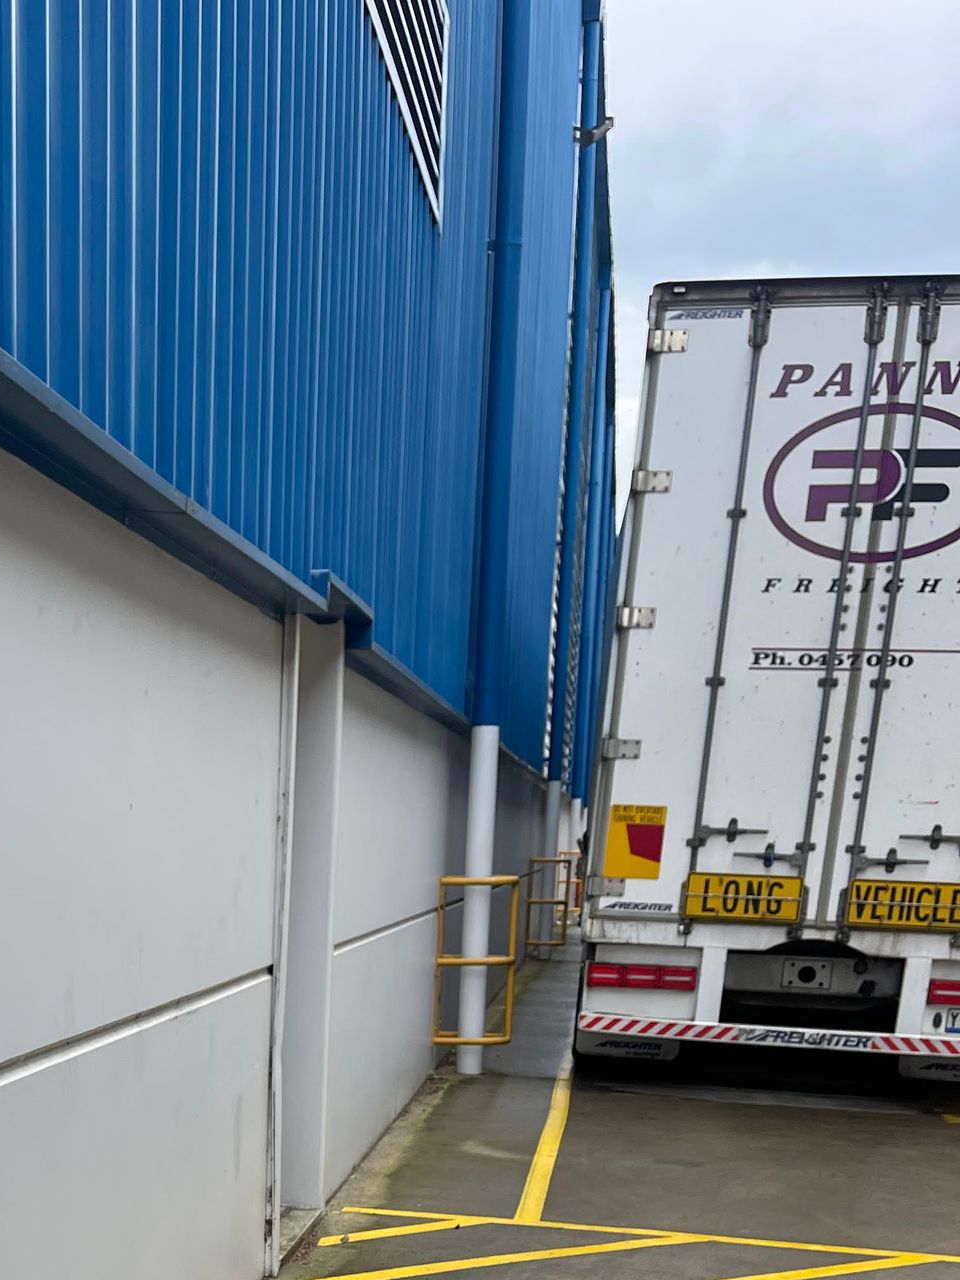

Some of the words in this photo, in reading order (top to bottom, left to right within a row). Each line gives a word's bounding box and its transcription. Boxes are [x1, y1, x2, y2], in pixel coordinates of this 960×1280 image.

[761, 577, 960, 593] FREIGH
[751, 652, 792, 666] Ph.
[701, 878, 784, 915] LONG
[854, 884, 960, 924] VEHICLE
